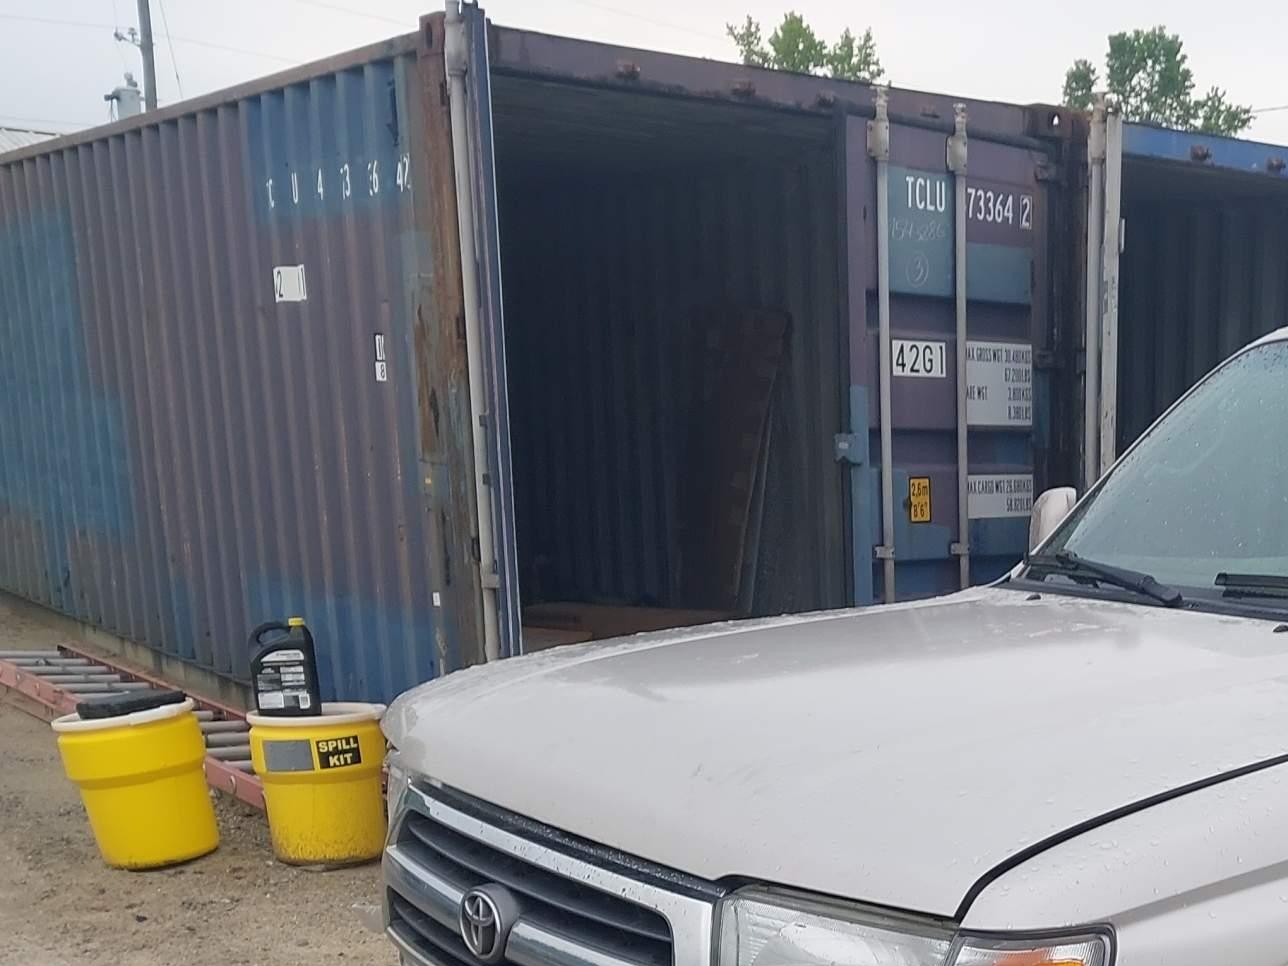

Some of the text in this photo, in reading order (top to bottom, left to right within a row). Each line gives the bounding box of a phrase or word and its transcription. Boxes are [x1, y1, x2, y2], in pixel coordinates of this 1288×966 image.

[905, 175, 946, 212] TCLU
[967, 187, 1013, 225] 73364
[895, 343, 944, 375] 42G1
[318, 737, 358, 753] SPILL
[328, 753, 353, 767] KIT
